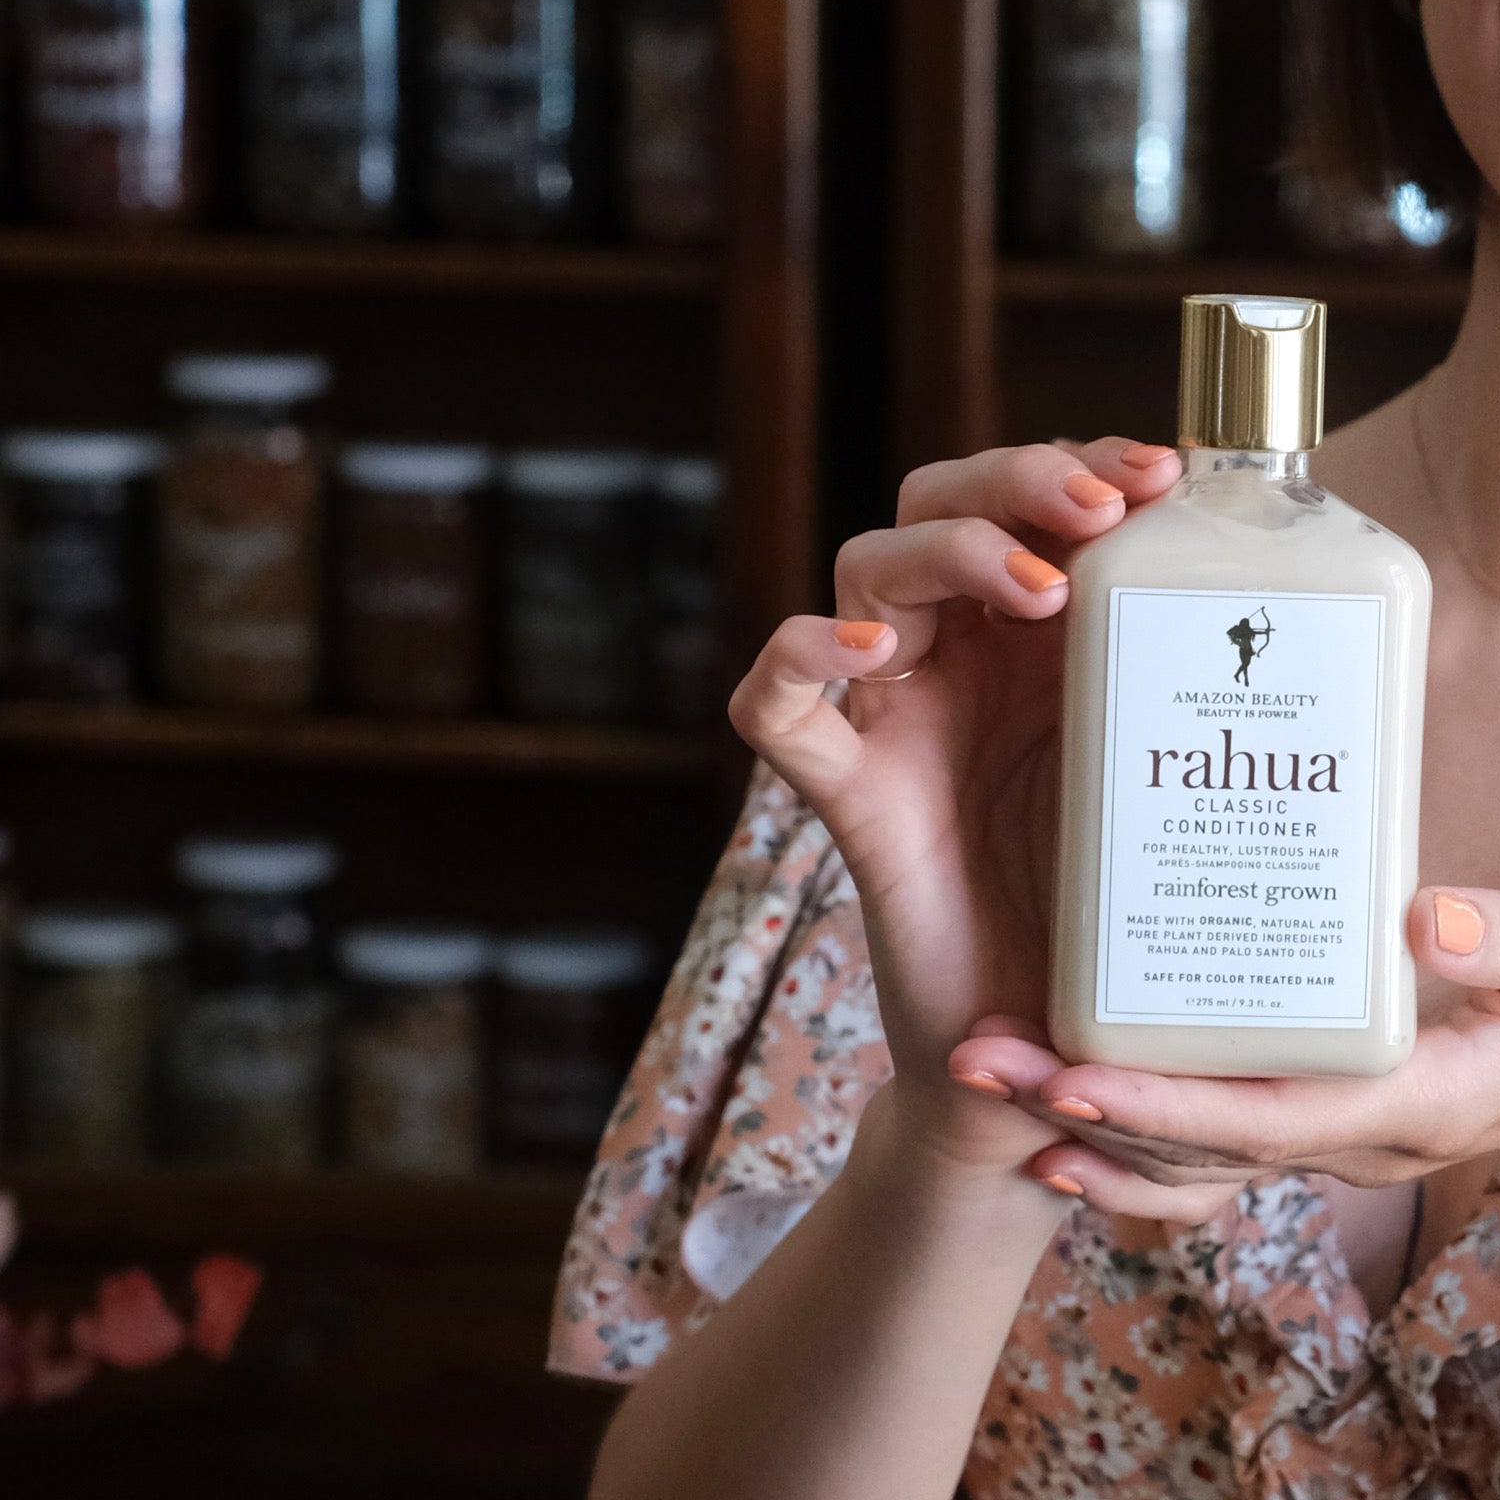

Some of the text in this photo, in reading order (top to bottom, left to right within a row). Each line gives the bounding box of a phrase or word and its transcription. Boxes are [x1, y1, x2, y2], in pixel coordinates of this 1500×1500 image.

[1172, 691, 1320, 708] AMAZON BEAUTY
[1196, 707, 1298, 720] BEAUTY IS POWER
[1194, 797, 1288, 815] CLASSIC
[1162, 818, 1317, 838] CONDITIONER
[1142, 842, 1340, 859] FOR HEALTHY, LUSTROUS HAIR
[1264, 860, 1321, 871] CLASSIQUE
[1152, 876, 1337, 908] rainforest grown
[1126, 914, 1345, 931] MADE WITH ORGANIC, NATURAL AND
[1127, 928, 1343, 945] PURE PLANT DERIVED INGREDIENTS
[1147, 944, 1326, 959] RAHUA AND PALO SANTO OILS
[1143, 971, 1335, 987] SAFE FOR COLOR TREATED HAIR
[1216, 998, 1229, 1007] ml
